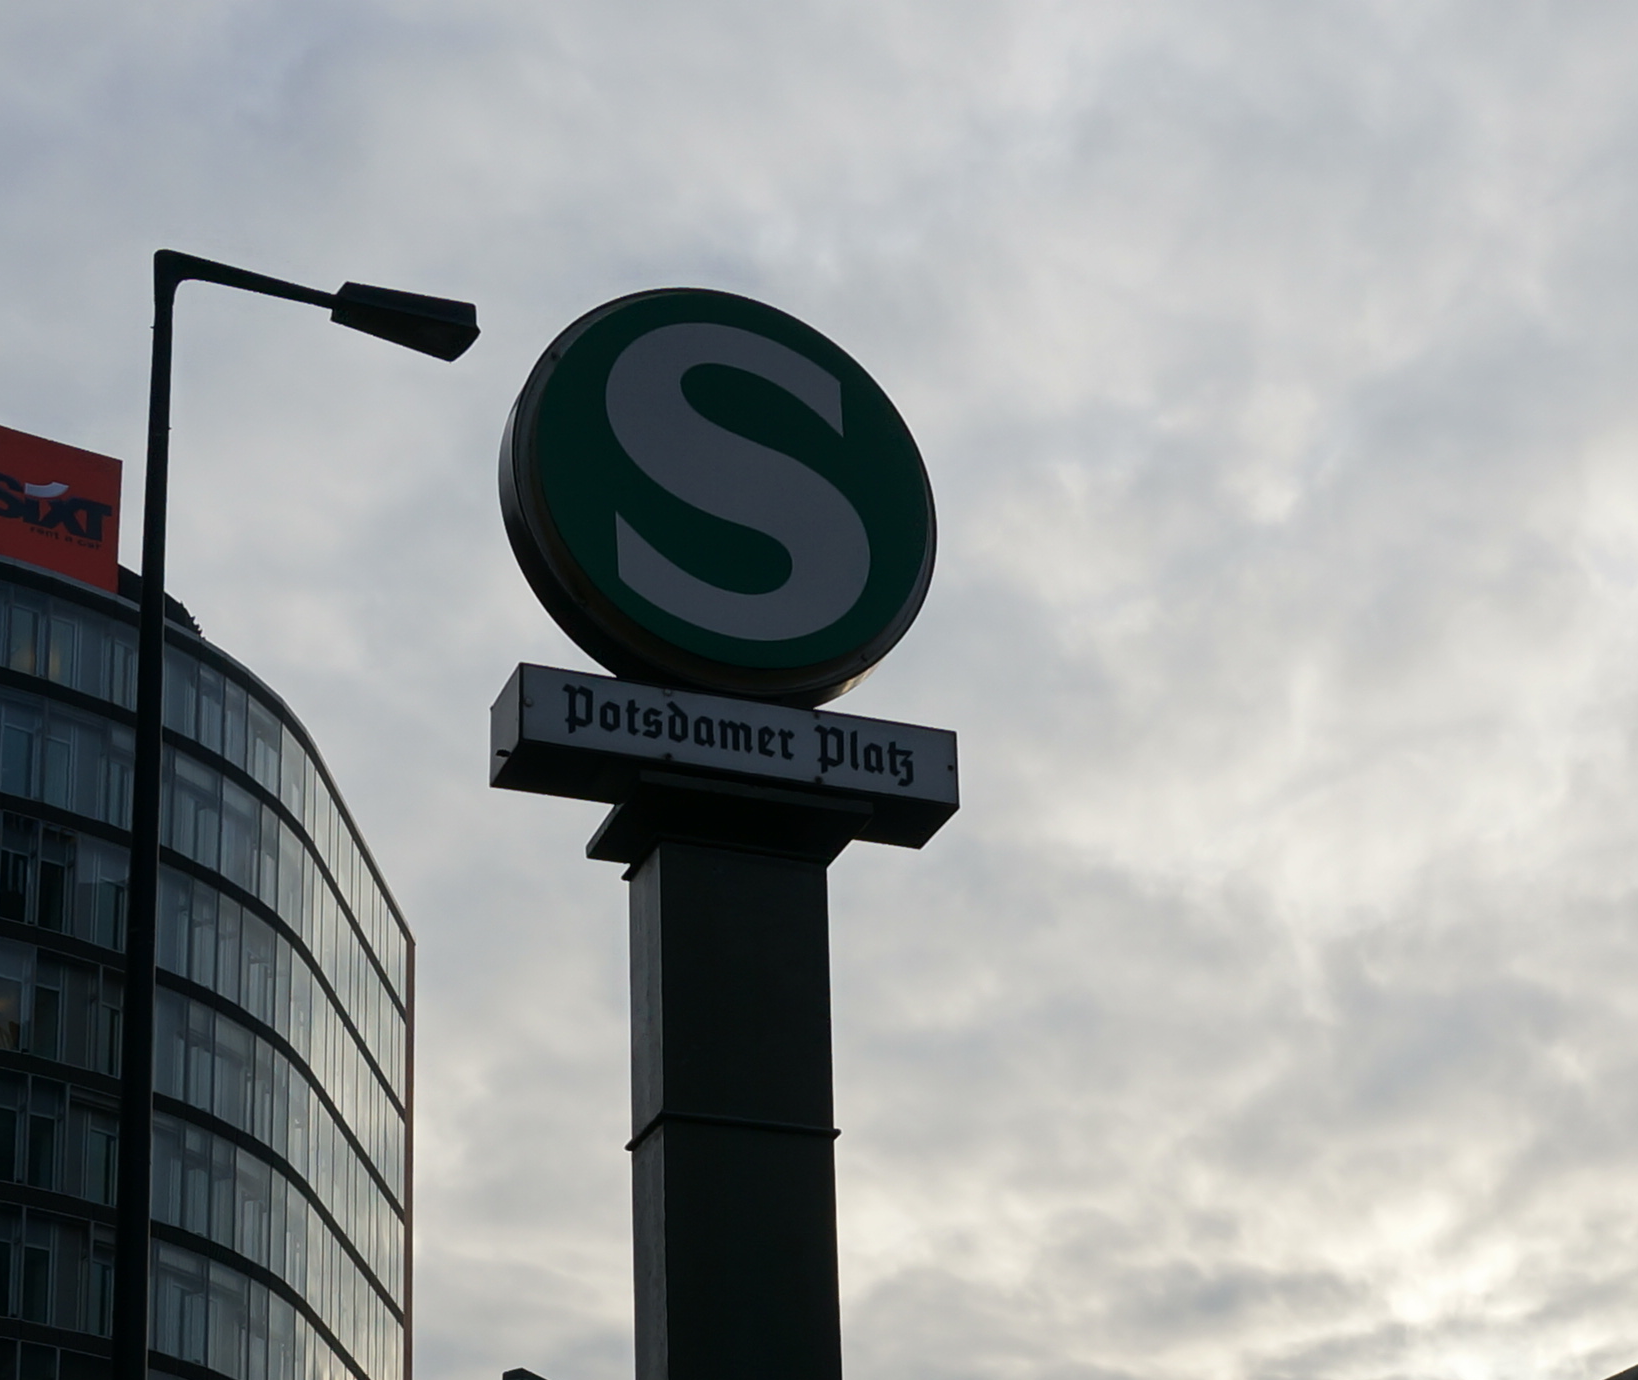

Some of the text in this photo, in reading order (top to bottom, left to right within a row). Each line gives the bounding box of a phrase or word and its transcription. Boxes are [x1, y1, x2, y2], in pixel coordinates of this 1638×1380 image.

[605, 321, 872, 642] S
[30, 526, 60, 540] rent
[77, 538, 102, 550] car
[563, 683, 915, 787] Potsdamer Platz
